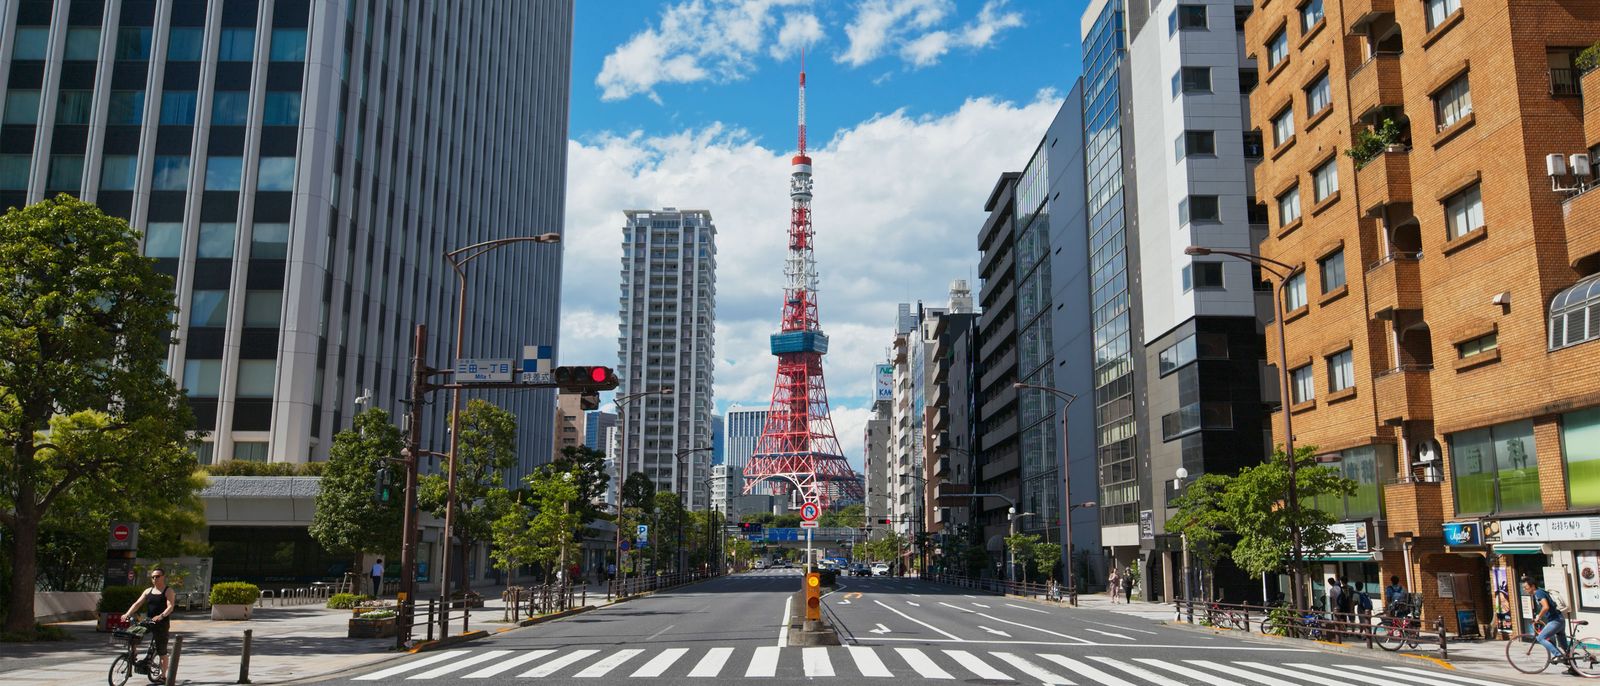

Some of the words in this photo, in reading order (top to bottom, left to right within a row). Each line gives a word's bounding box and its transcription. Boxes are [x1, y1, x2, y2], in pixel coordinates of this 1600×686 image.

[458, 363, 509, 374] 三田一丁目
